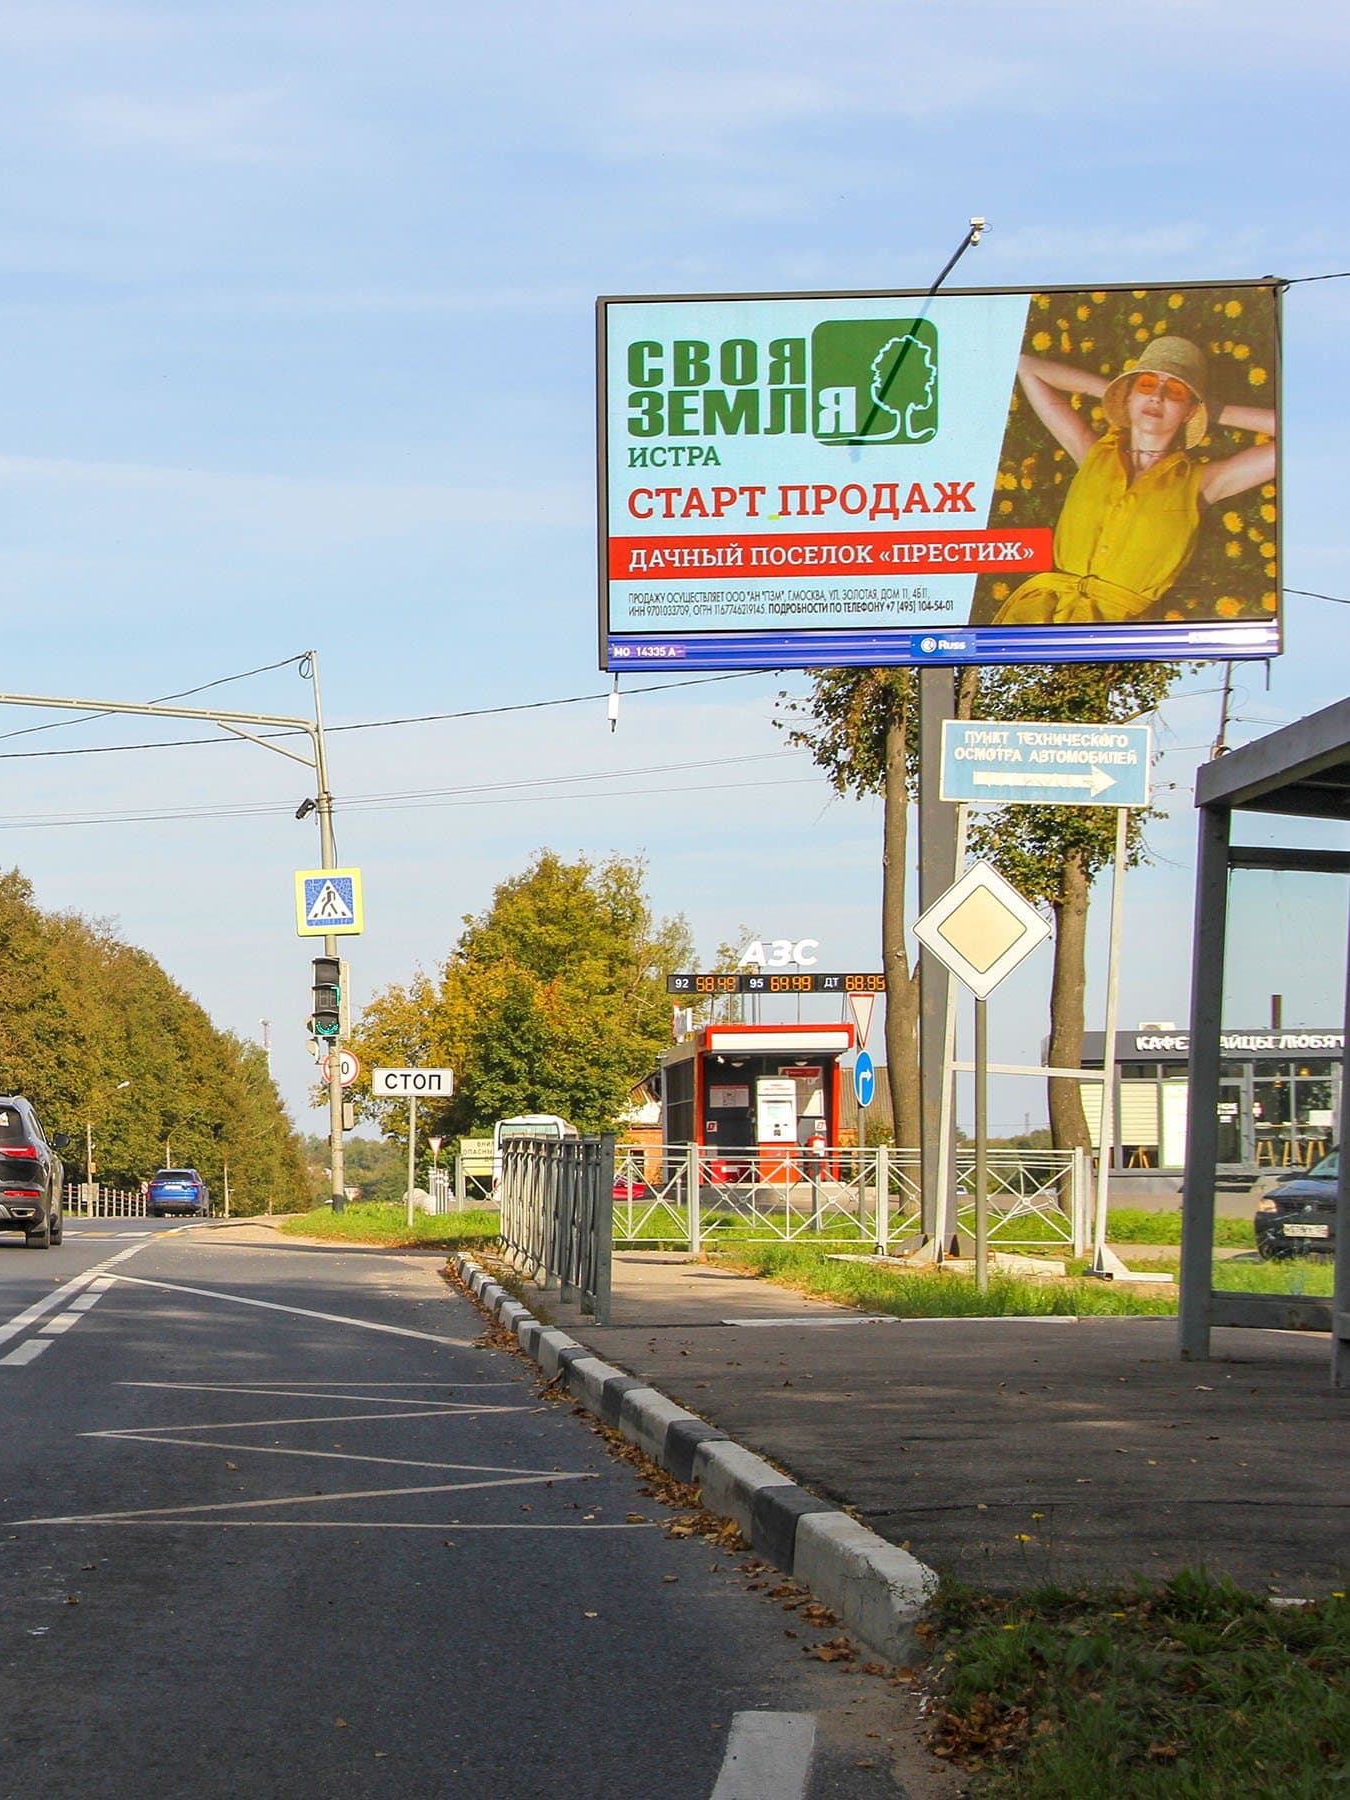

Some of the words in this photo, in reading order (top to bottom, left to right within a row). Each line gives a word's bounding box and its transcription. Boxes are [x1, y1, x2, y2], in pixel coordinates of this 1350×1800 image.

[627, 338, 806, 388] СВОЯ
[627, 387, 856, 438] ЗЕМЛЯ
[628, 446, 721, 467] ИСТРА
[627, 485, 766, 519] СТАРТ
[777, 482, 976, 521] ПРОДАЖ
[628, 543, 744, 572] ДАЧНЫЙ
[750, 545, 873, 567] ПОСЕЛОК
[879, 541, 1034, 564] «ПРЕСТИЖ»
[629, 592, 665, 604] ПРОДАЖУ
[667, 591, 724, 603] ОСУЩЕСТВЛЯЕТ
[725, 591, 746, 602] ООО
[881, 588, 899, 600] ДОМ
[629, 605, 645, 617] ИНН
[693, 604, 712, 616] ОГРН
[769, 602, 828, 615] ПОДРОБНОСТИ
[830, 602, 842, 613] ПО
[844, 601, 885, 613] ТЕЛЕФОНУ
[886, 601, 895, 612] +7
[918, 599, 954, 612] 104-54-01
[964, 731, 1010, 746] ПУНКТ
[1016, 731, 1128, 748] ТЕХНИЧЕСКОГО
[954, 747, 1023, 763] ОСМОТРА
[1028, 749, 1137, 765] АВТОМОБИЛЕЙ
[738, 939, 819, 967] АЗС
[675, 978, 689, 989] 92
[749, 978, 764, 989] 95
[824, 977, 840, 989] ДТ
[1135, 1035, 1191, 1051] КАФЕ
[1220, 1033, 1276, 1052] АЙЦЫ
[385, 1073, 441, 1090] СТОП
